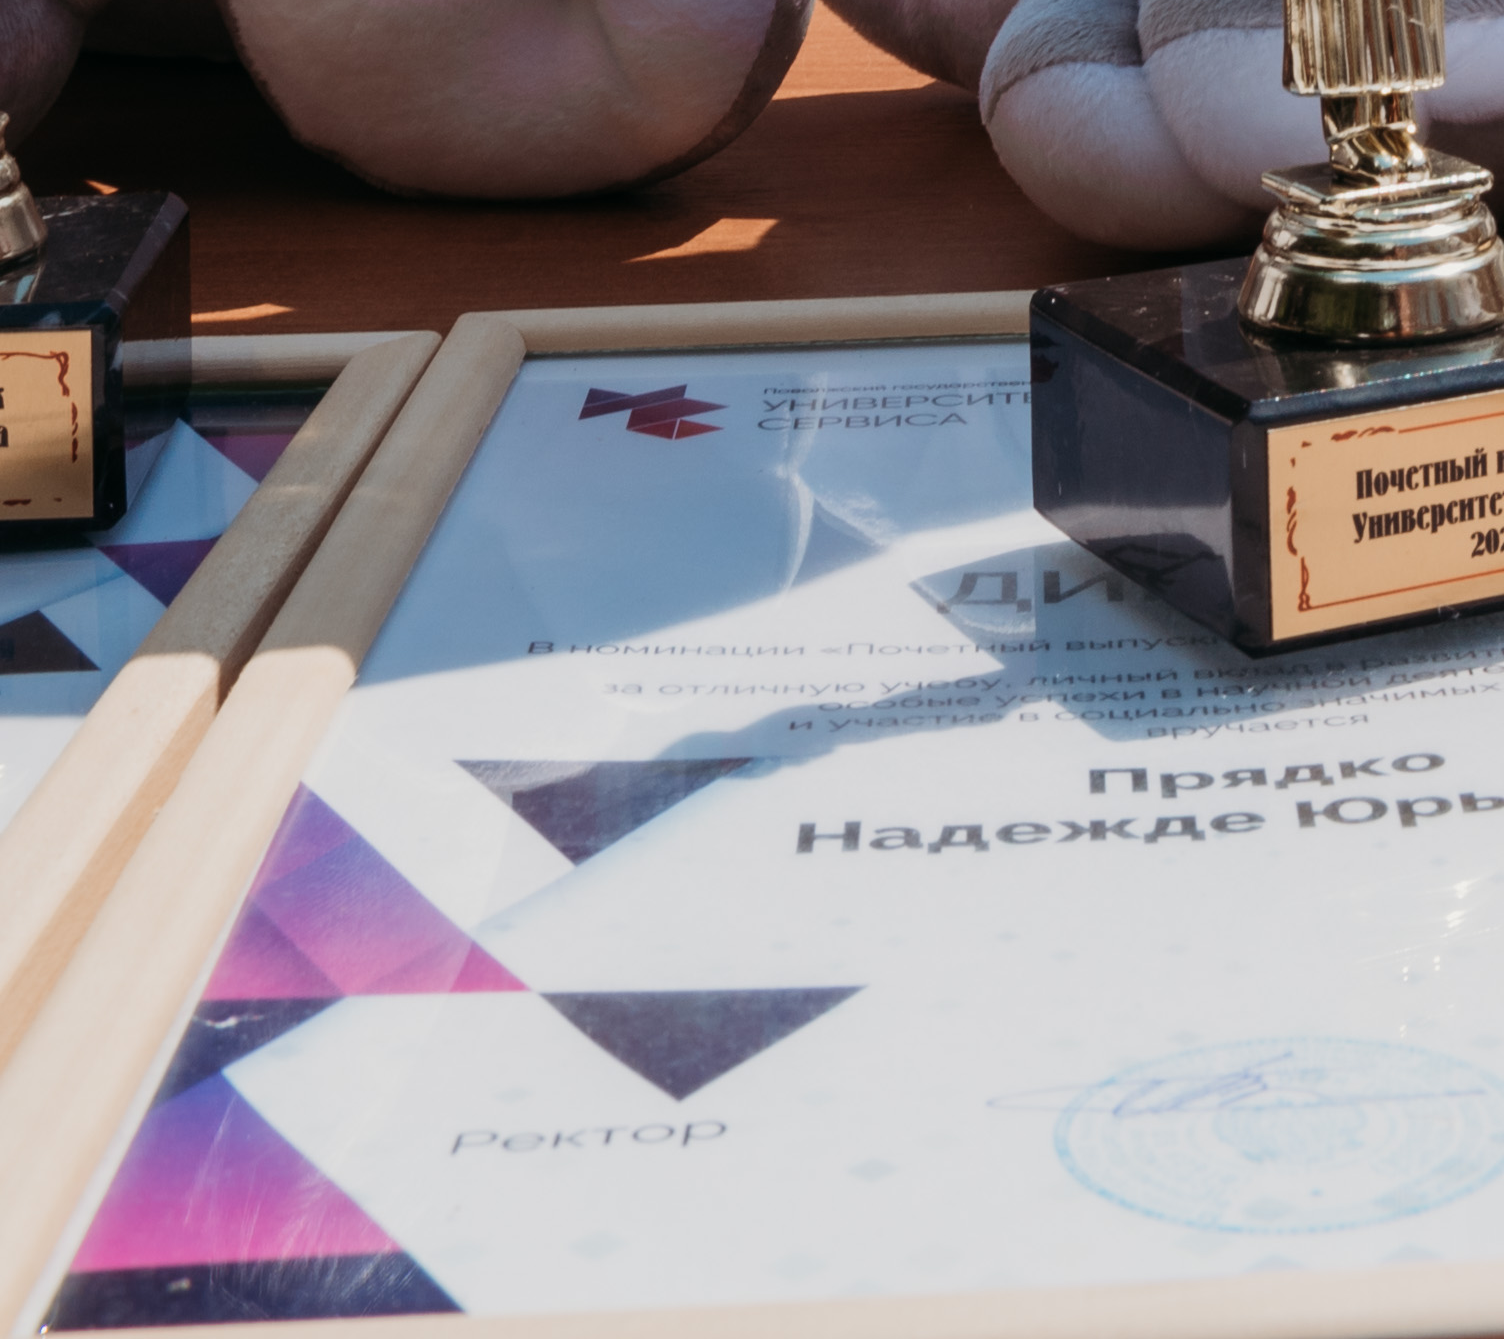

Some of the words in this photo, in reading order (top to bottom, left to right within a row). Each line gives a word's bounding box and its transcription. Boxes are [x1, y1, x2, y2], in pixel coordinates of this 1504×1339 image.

[763, 392, 1031, 413] УНИВЕРСИТЕ
[764, 383, 886, 395] Поволжский
[892, 380, 1031, 392] государствен
[757, 412, 968, 430] СЕРВИСА
[1356, 448, 1488, 500] Почетный
[527, 641, 555, 655] В
[570, 642, 805, 659] номинации
[820, 638, 1050, 657] «Почетный
[1066, 635, 1218, 653] выпуск
[603, 682, 643, 695] за
[659, 680, 866, 699] отличную
[1028, 669, 1178, 687] личный
[817, 692, 980, 711] особые
[996, 689, 1145, 710] успехи
[1161, 688, 1181, 700] в
[1197, 673, 1371, 699] научной
[789, 719, 813, 731] и
[828, 711, 1000, 734] участие
[1020, 711, 1039, 722] в
[1055, 701, 1286, 726] социально
[1299, 682, 1501, 710] значимых
[1147, 713, 1370, 740] вручается
[1089, 752, 1445, 798] Прядко
[796, 809, 1266, 853] Надежде
[451, 1120, 727, 1156] Ректор
